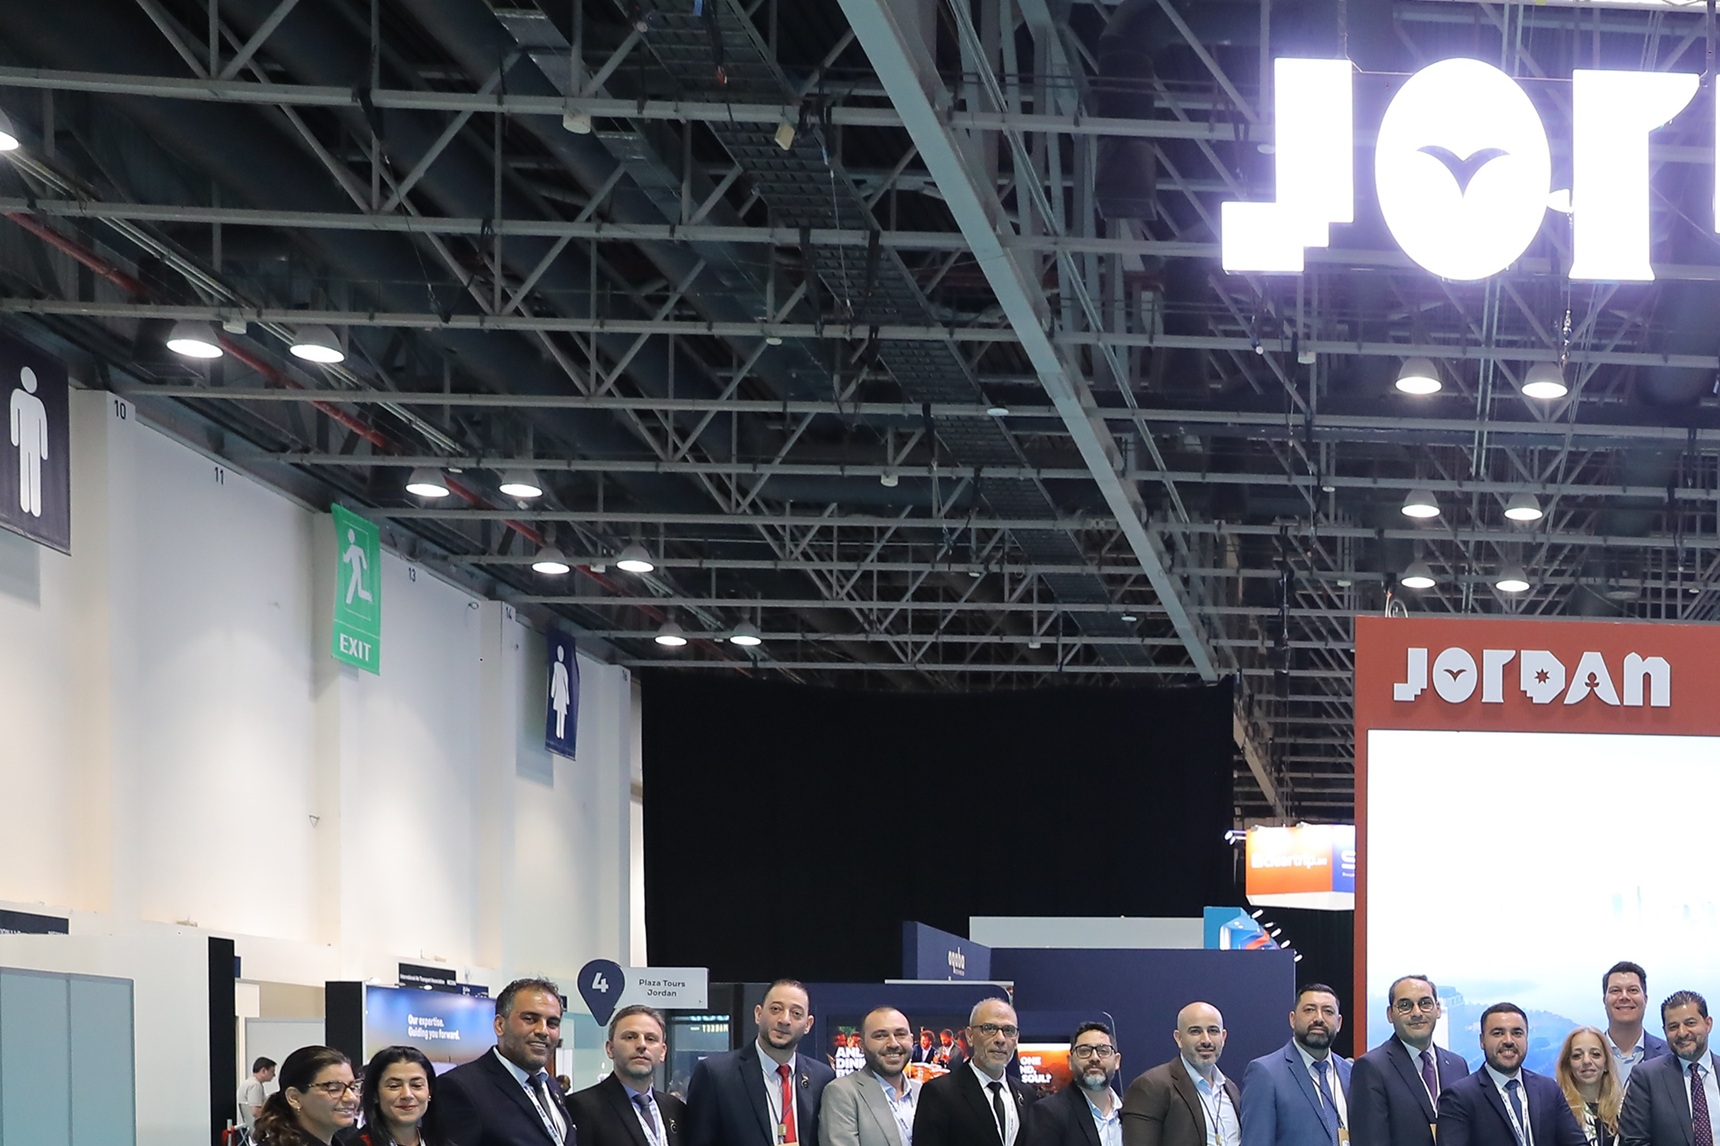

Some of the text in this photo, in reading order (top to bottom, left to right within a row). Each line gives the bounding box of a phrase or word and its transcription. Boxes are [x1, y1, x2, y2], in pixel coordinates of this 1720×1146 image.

[114, 399, 127, 420] 10
[215, 466, 225, 485] 11
[408, 567, 417, 582] 13
[340, 631, 372, 662] EXIT
[1393, 646, 1671, 707] JORDAN
[591, 972, 610, 993] 4
[639, 979, 686, 988] Plaza Tours
[647, 989, 677, 997] Jordan
